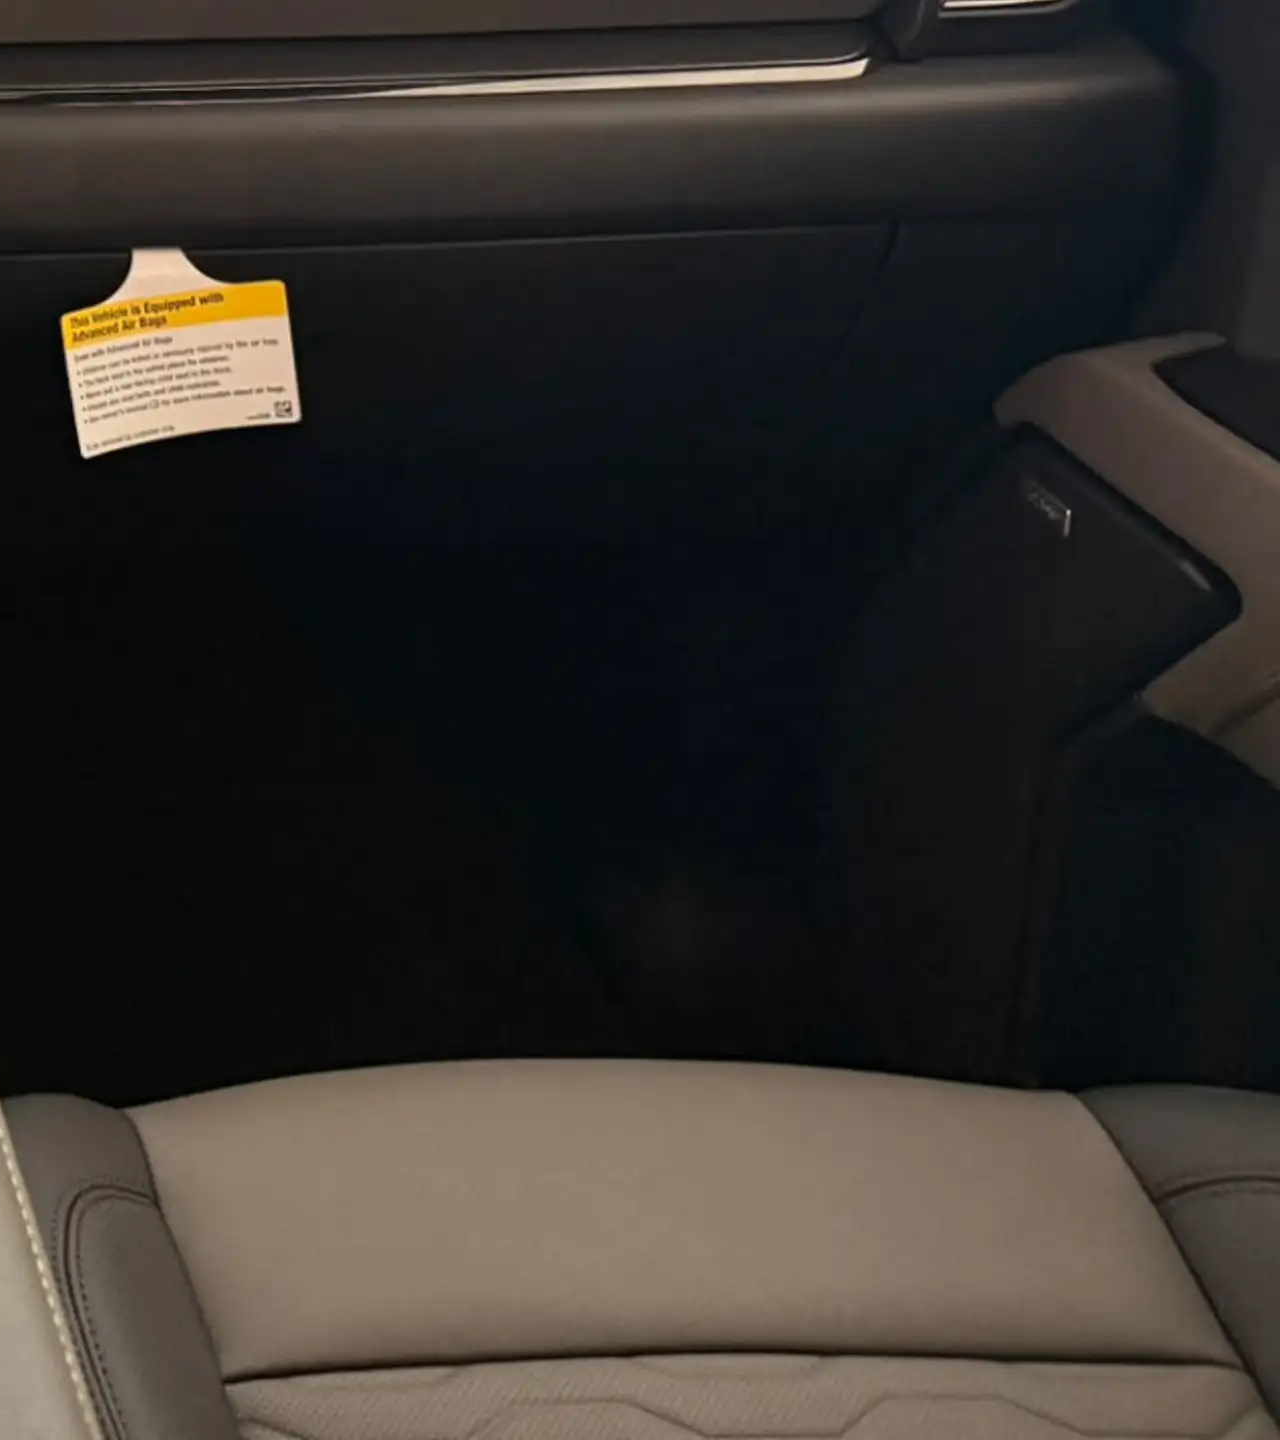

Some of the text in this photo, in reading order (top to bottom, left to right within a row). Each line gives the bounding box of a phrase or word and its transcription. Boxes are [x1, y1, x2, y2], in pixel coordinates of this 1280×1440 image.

[70, 292, 225, 329] This Vehicle is Equipped with
[72, 315, 168, 342] Advanced Air Bags
